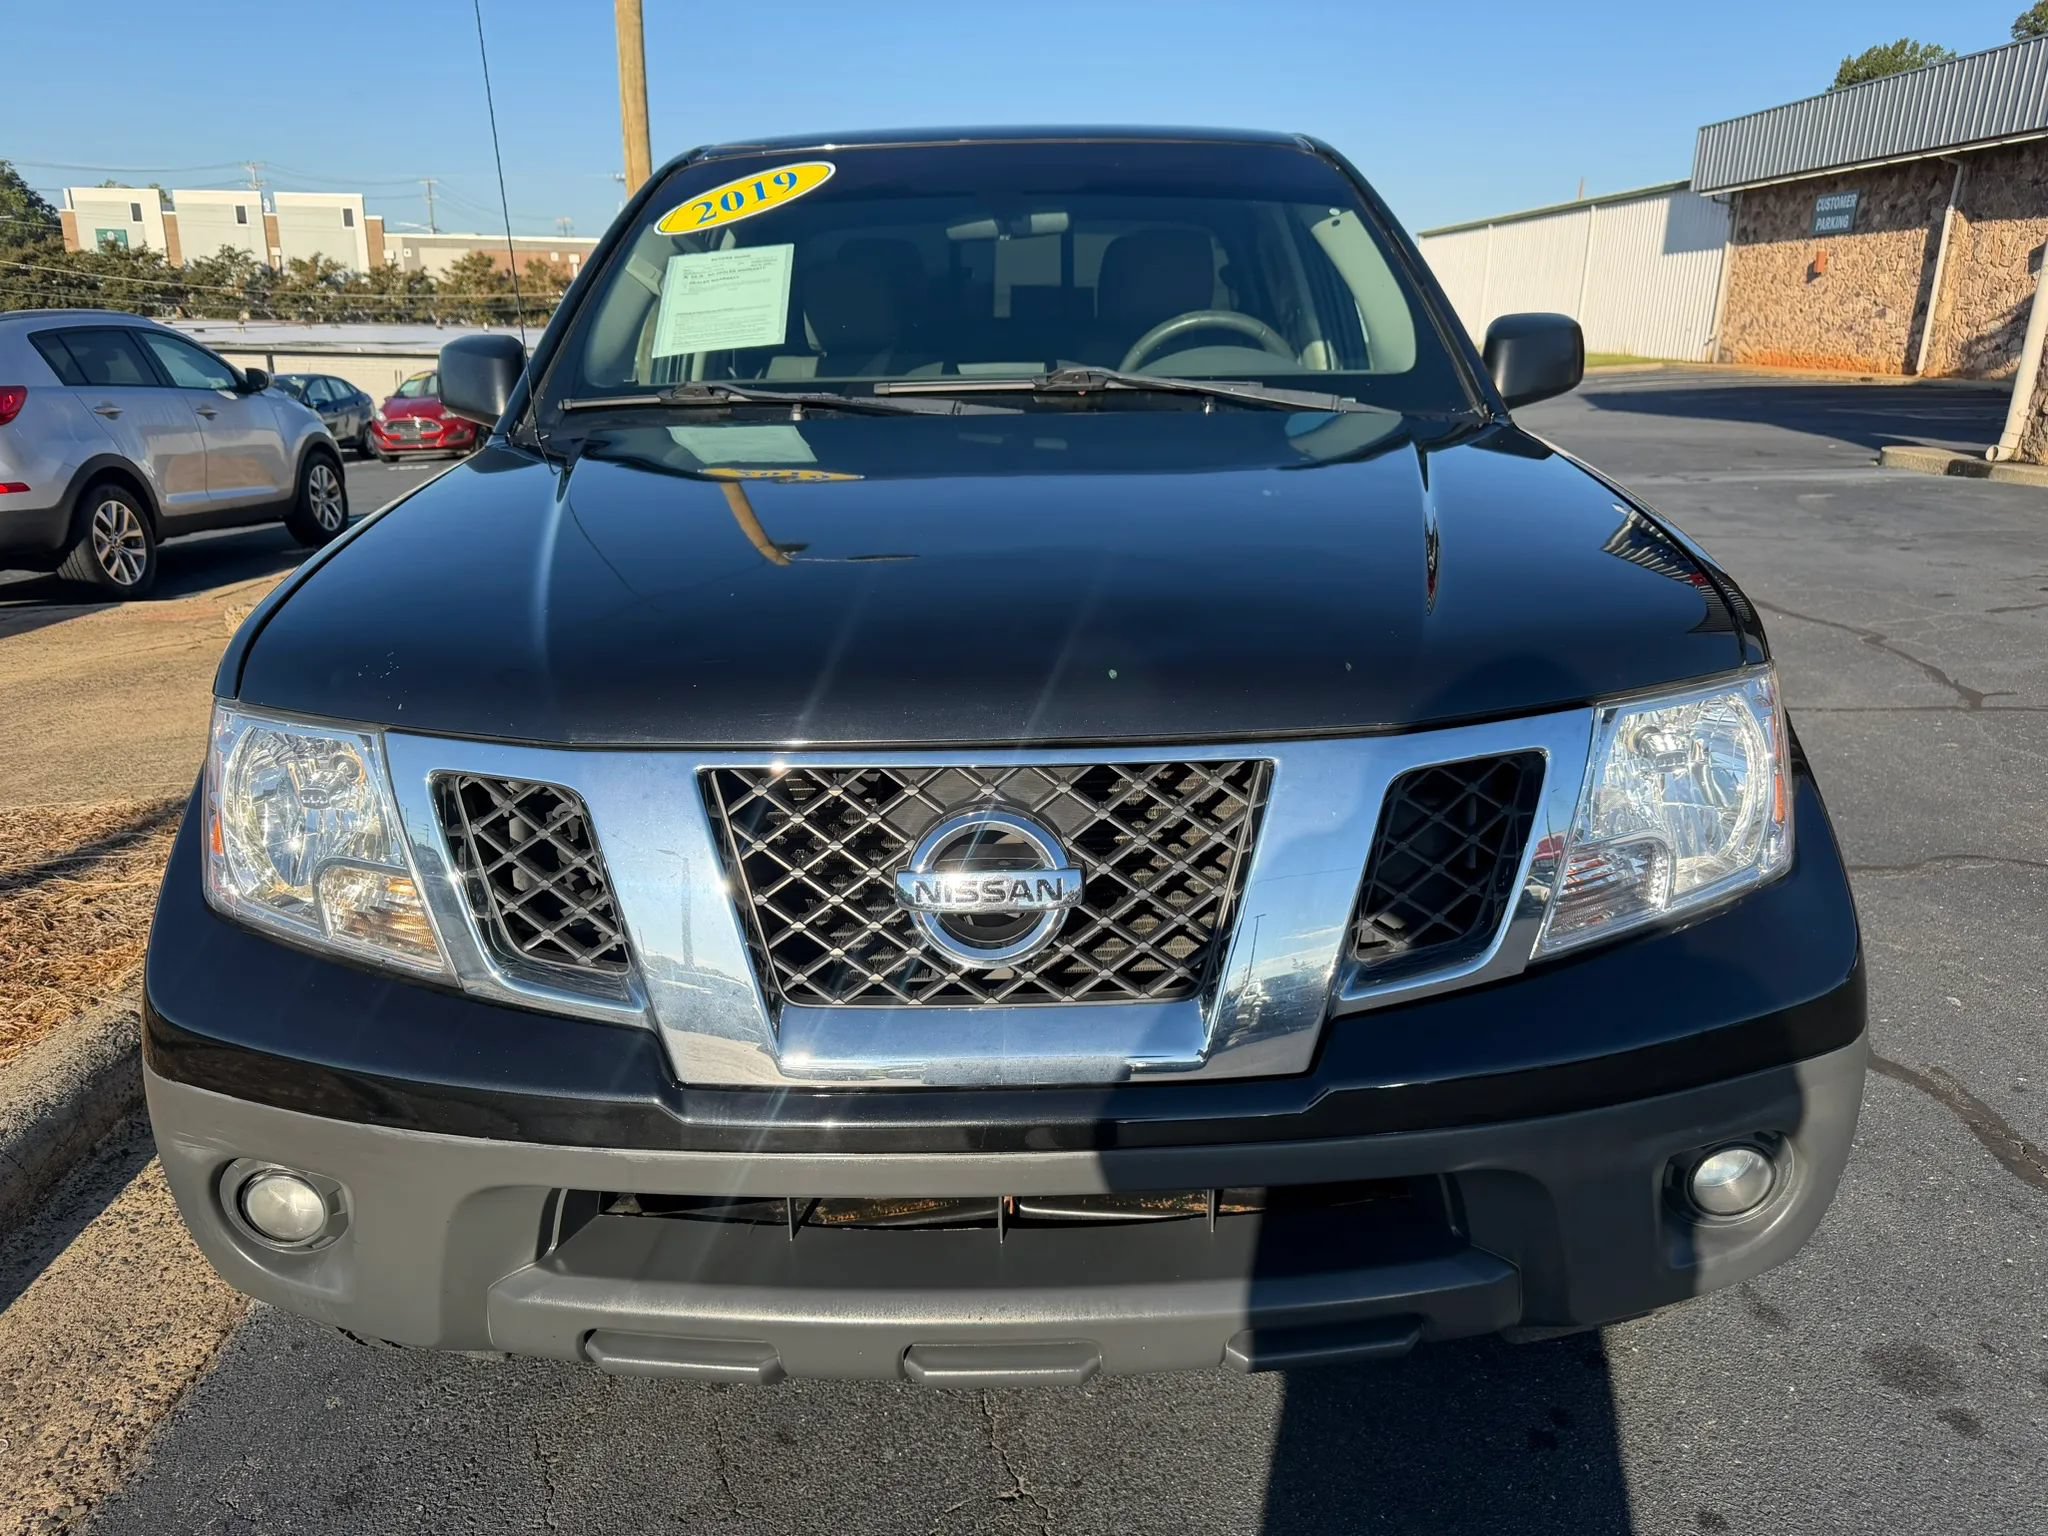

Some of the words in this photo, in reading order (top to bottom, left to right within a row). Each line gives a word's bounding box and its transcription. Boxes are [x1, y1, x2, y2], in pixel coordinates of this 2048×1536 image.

[691, 171, 798, 225] 2019
[1816, 194, 1857, 212] CUSTOMER
[1815, 215, 1849, 231] PARKING
[914, 877, 1064, 904] NISSAN
